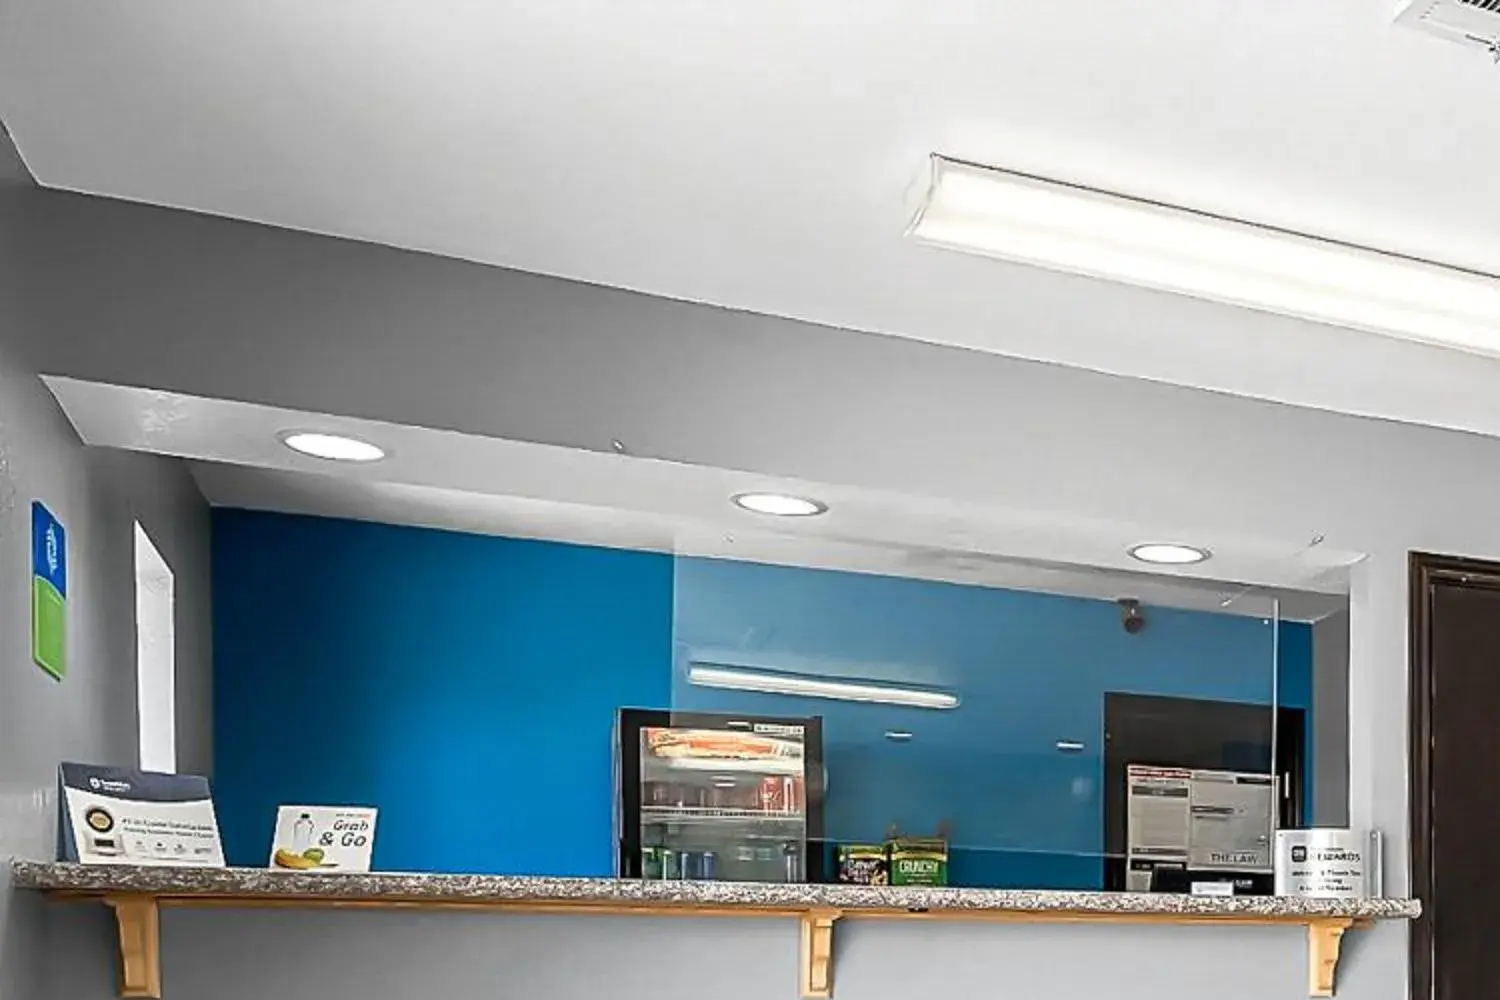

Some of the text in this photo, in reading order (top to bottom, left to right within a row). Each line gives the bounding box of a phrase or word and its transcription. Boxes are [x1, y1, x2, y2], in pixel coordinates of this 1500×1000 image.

[333, 819, 369, 831] Grab
[319, 831, 367, 847] & Go
[899, 860, 939, 873] CRUNCHY
